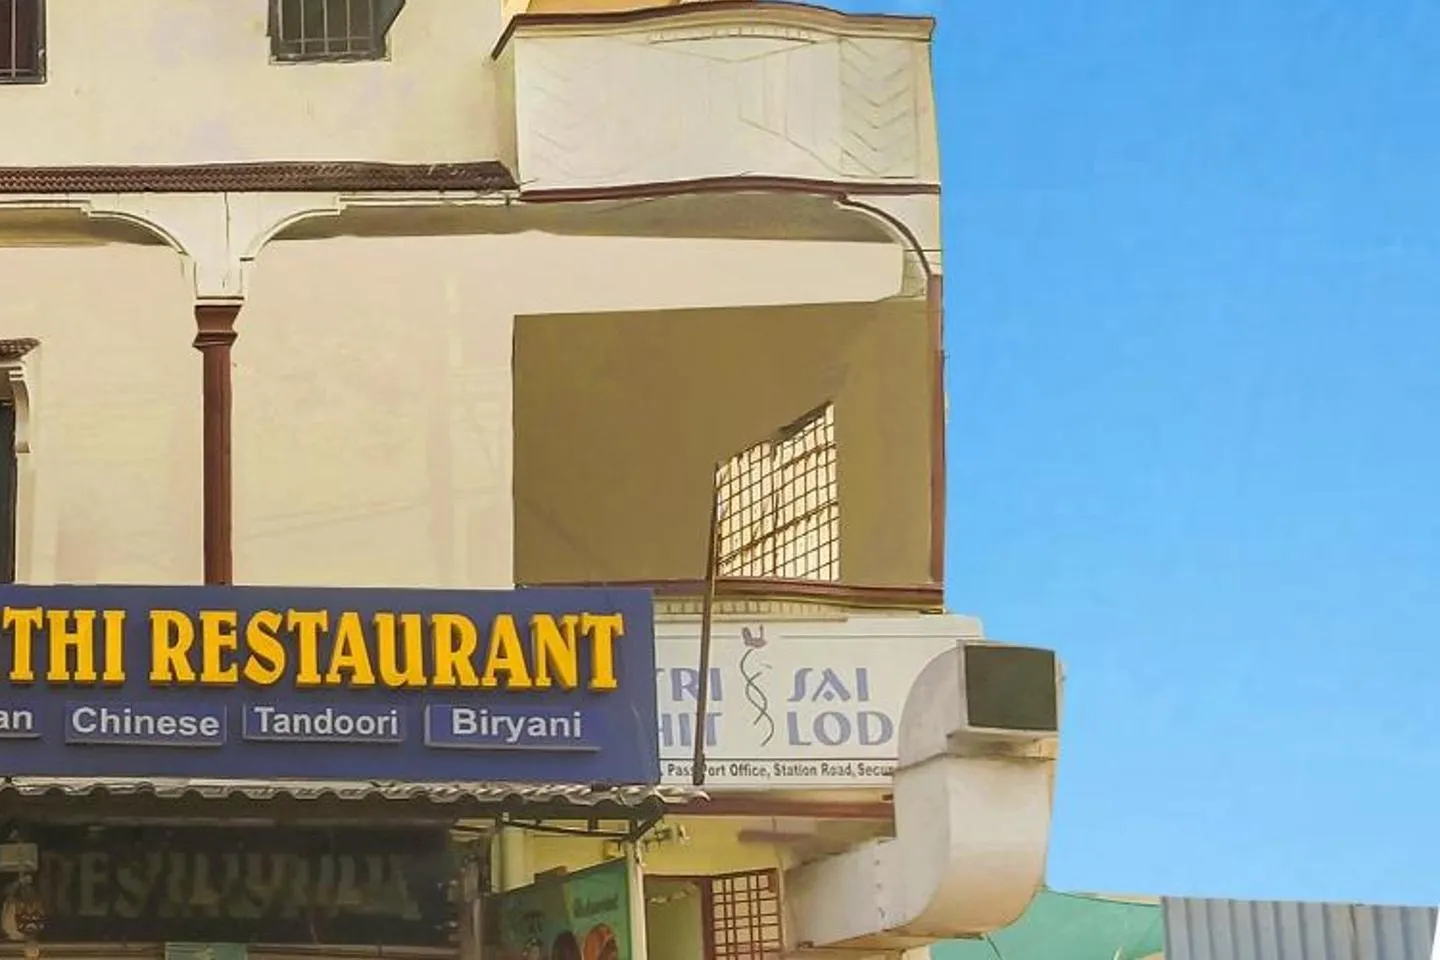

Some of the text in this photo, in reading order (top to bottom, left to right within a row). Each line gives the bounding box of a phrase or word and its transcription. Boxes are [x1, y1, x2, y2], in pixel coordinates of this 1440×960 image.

[148, 608, 624, 691] RESTAURANT
[656, 667, 870, 702] RI SAI
[72, 705, 220, 737] Chinese
[254, 706, 399, 736] Tandoori
[451, 707, 582, 742] Biryani
[786, 711, 894, 746] LOD
[729, 763, 771, 779] Office,
[773, 762, 817, 777] Station
